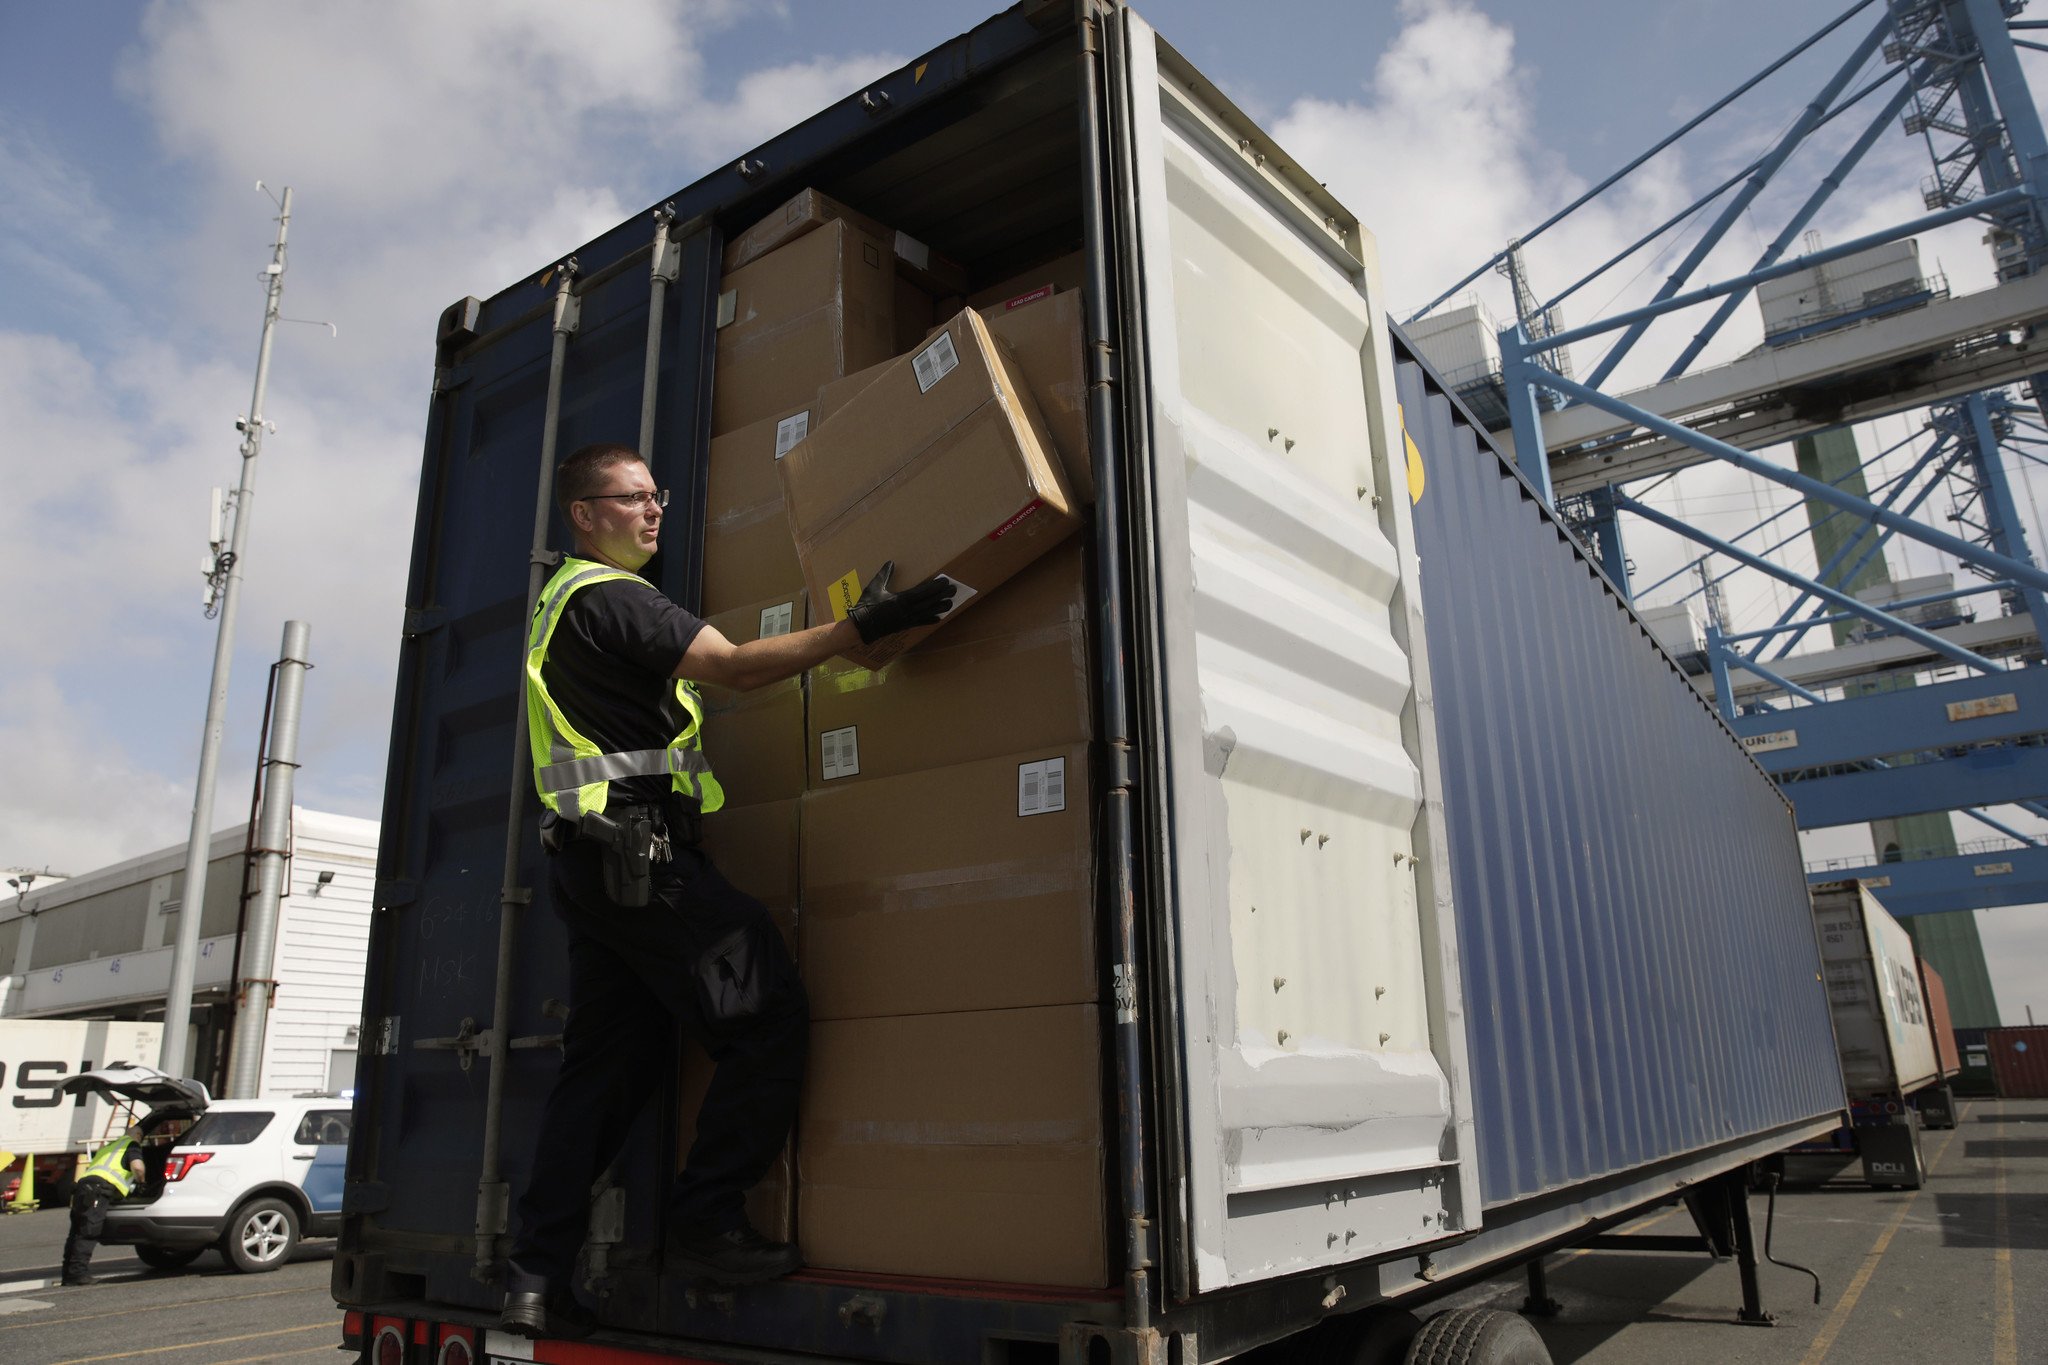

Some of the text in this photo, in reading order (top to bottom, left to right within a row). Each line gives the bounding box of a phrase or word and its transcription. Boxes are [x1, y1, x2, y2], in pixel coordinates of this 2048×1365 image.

[1011, 291, 1045, 307] LEAD CARTON
[997, 505, 1036, 536] LEAD CARTON
[202, 942, 215, 958] 47
[110, 958, 121, 974] 46
[52, 968, 63, 984] 45
[0, 1060, 122, 1108] SK
[1871, 1161, 1905, 1173] DCLI
